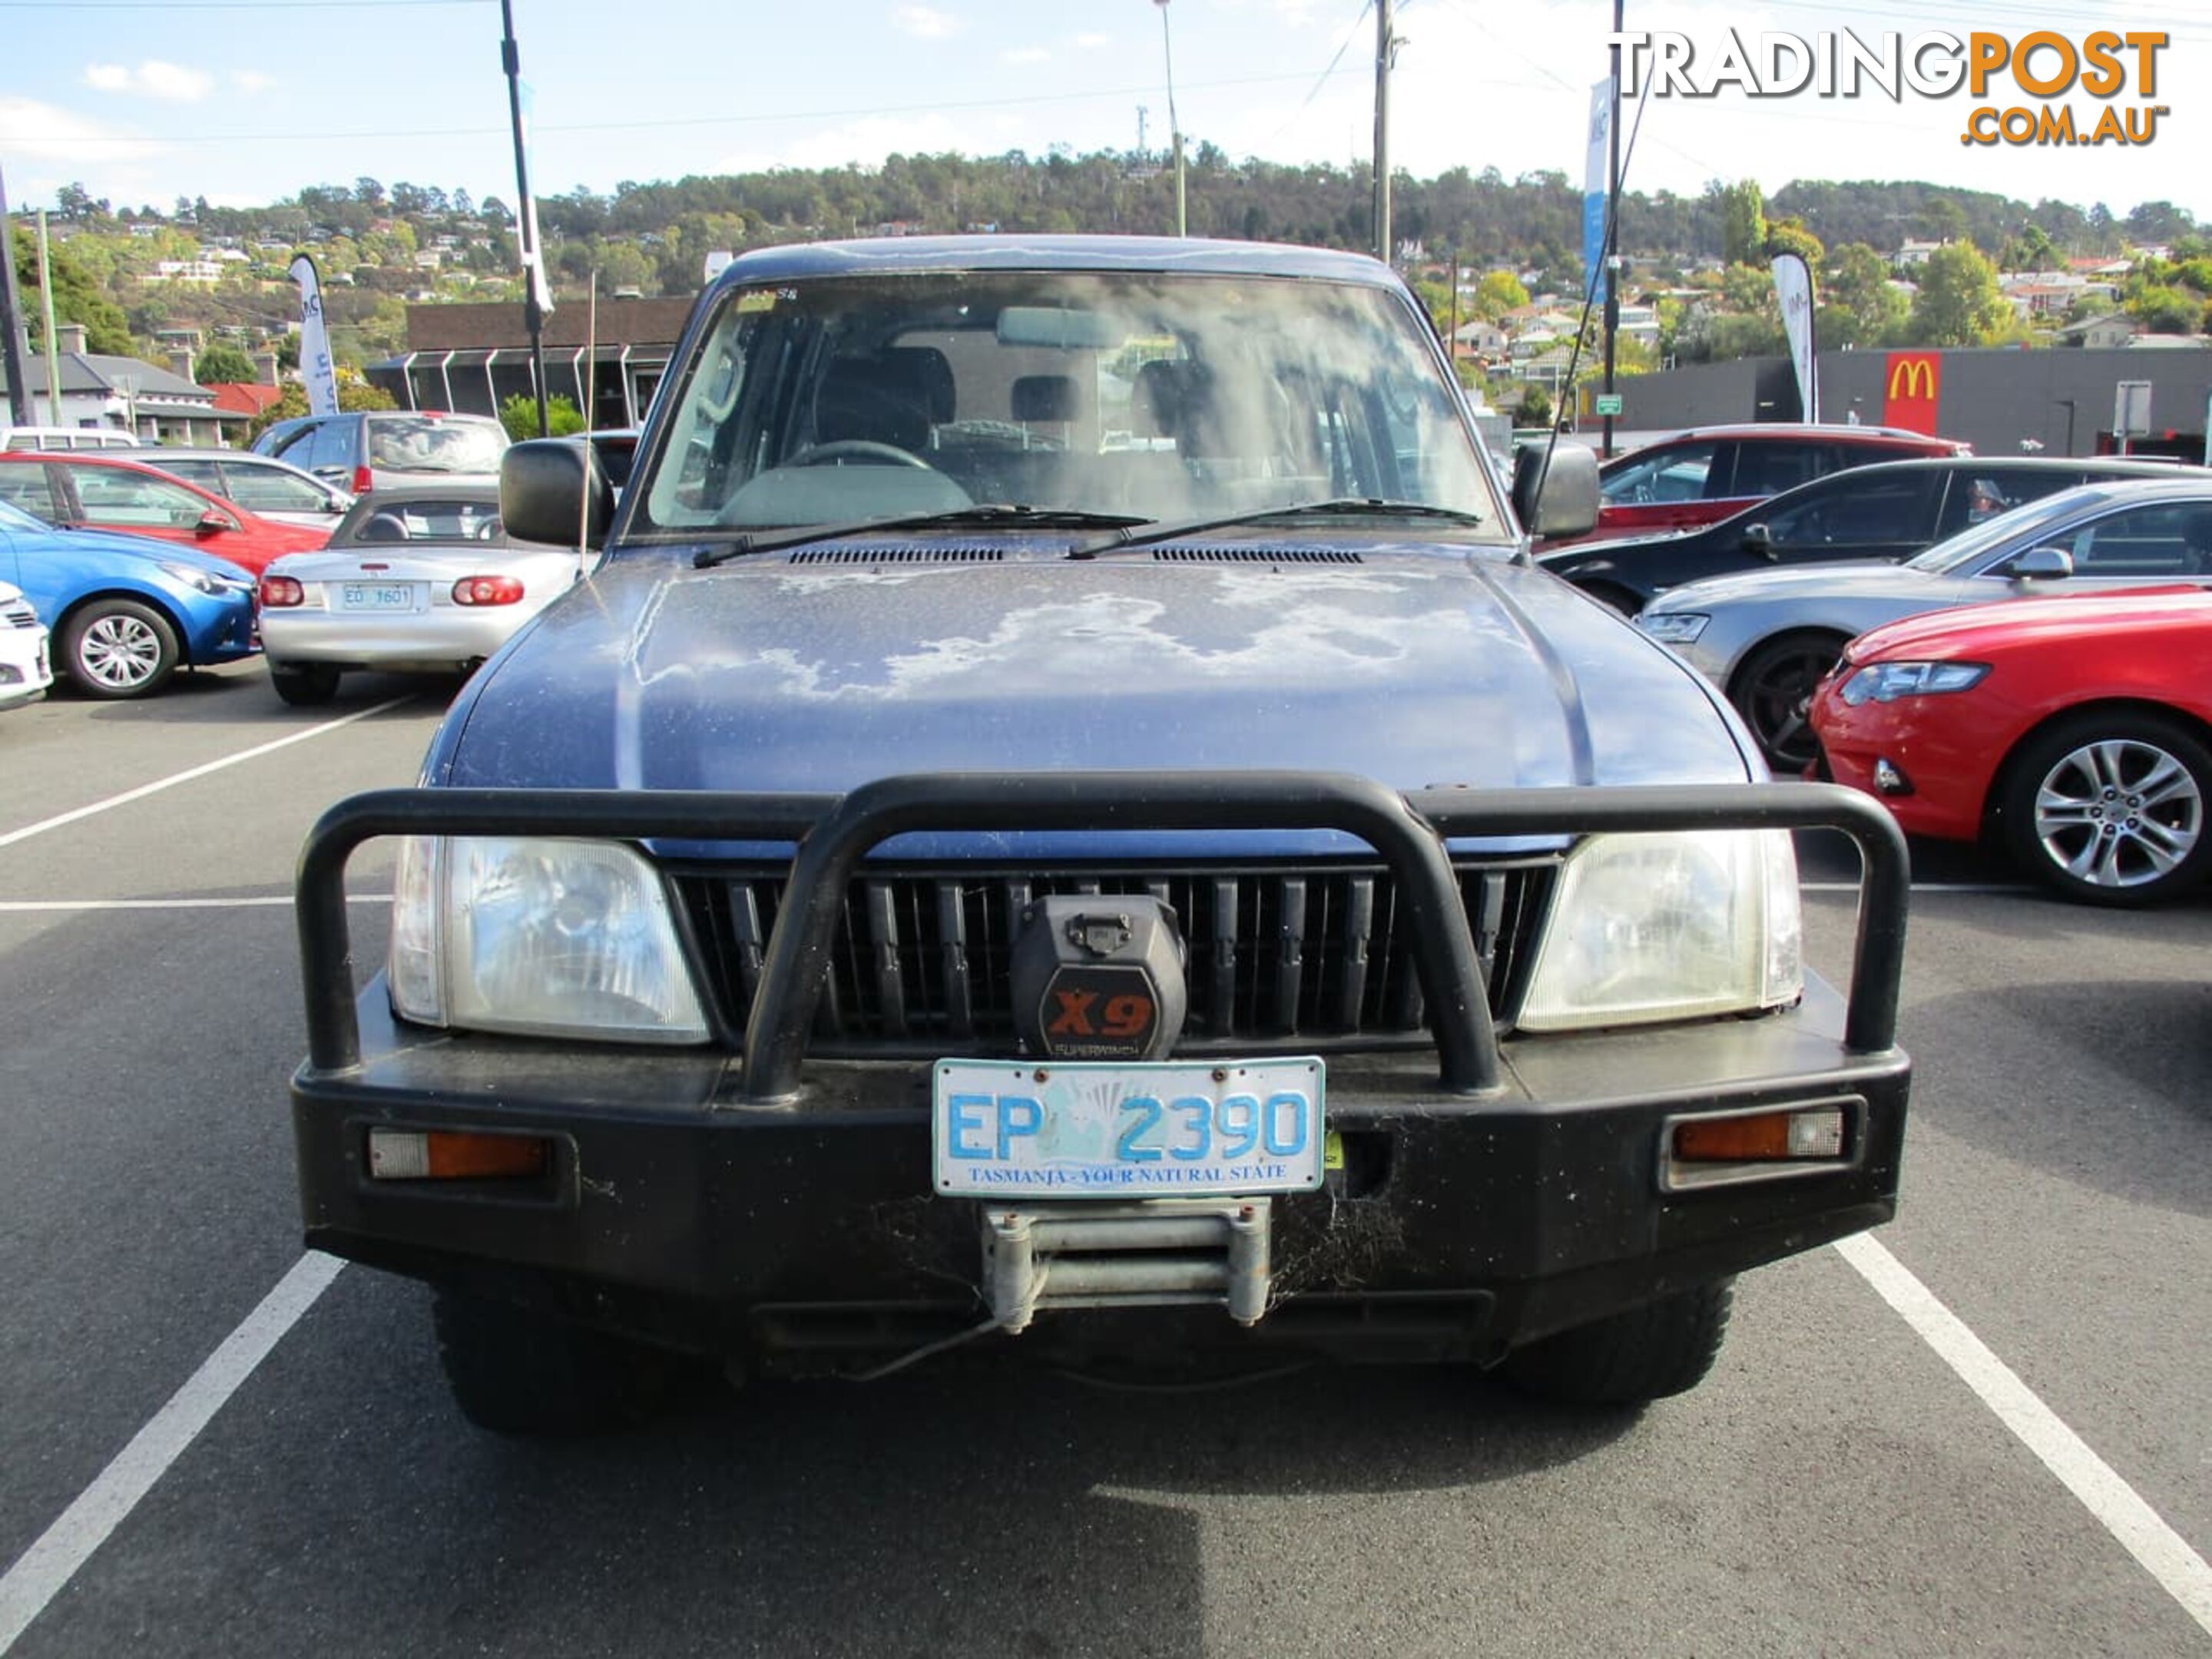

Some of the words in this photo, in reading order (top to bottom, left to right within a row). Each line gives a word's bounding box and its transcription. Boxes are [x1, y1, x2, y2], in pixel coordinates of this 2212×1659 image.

[377, 590, 409, 602] 1601
[948, 1094, 1045, 1161] EP
[1117, 1091, 1309, 1161] 2390
[969, 1167, 1065, 1185] TASMANIA
[1081, 1168, 1133, 1183] YOUR
[1140, 1167, 1225, 1182] NATURAL
[1230, 1164, 1287, 1180] STATE
